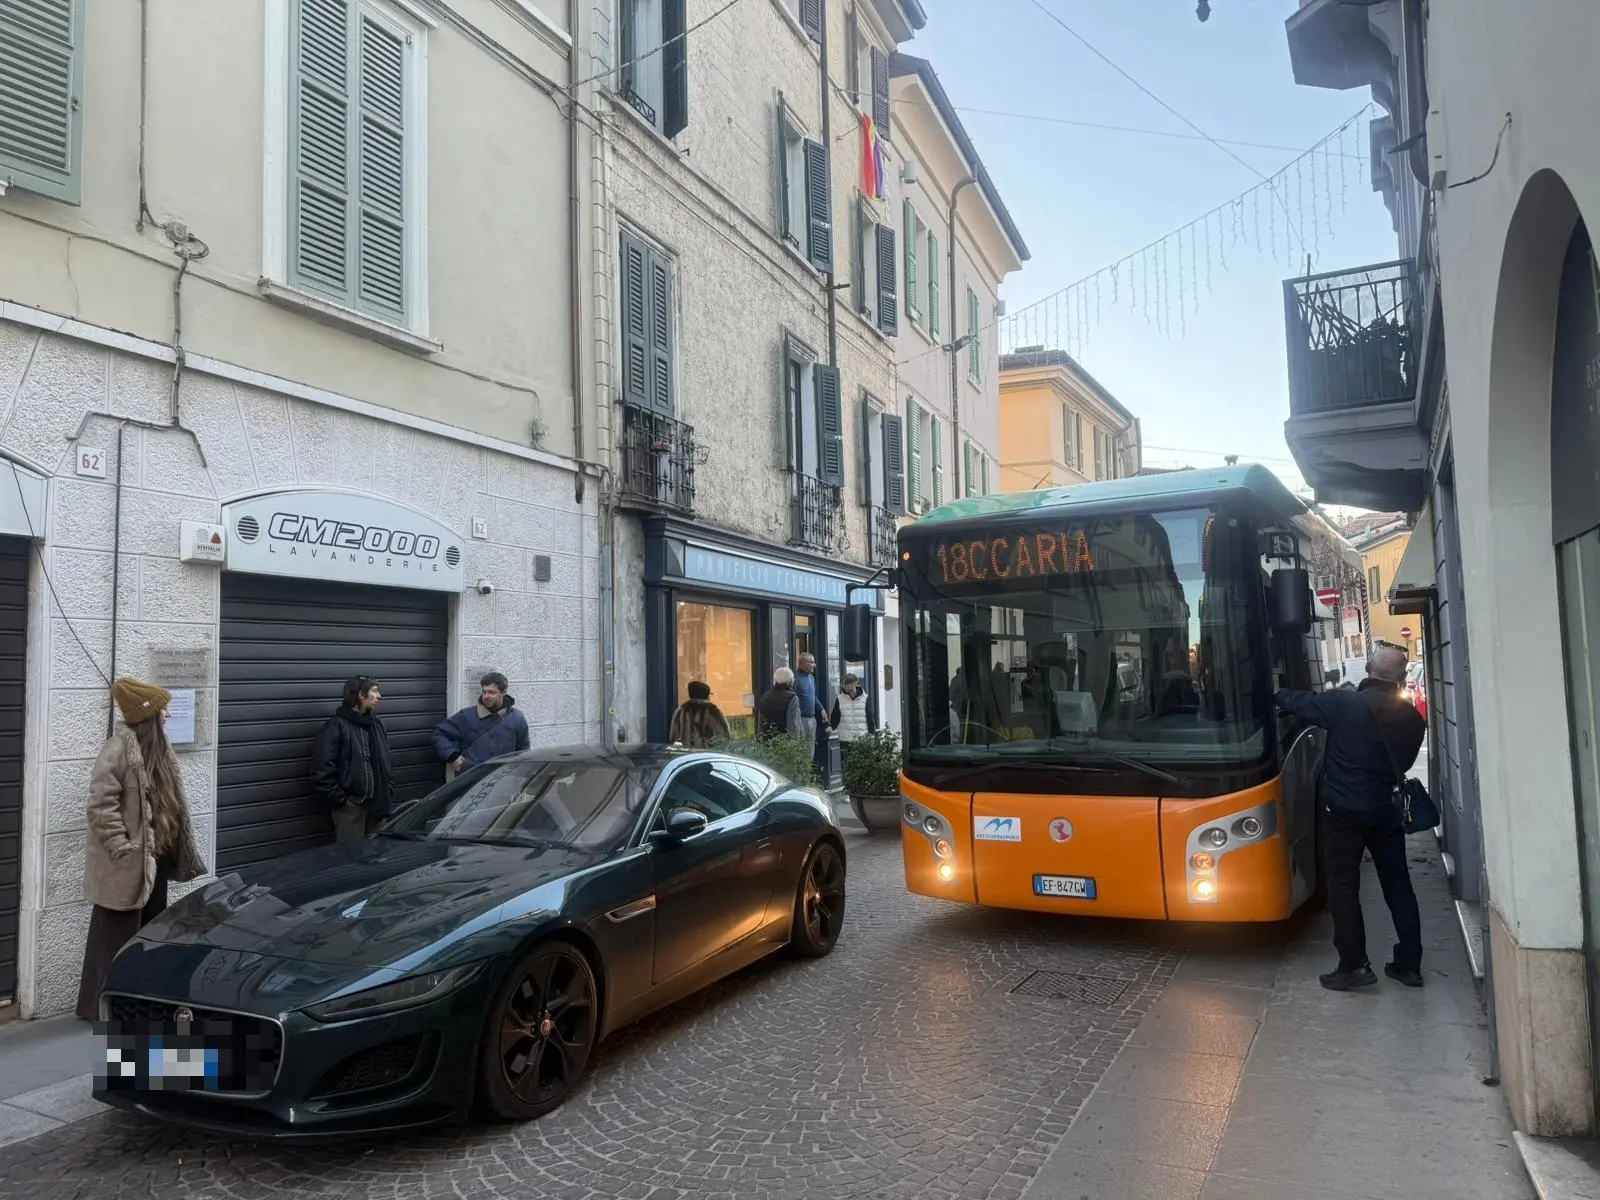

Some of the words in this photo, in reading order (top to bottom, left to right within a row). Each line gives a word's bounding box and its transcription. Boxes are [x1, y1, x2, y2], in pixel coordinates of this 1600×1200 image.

[268, 512, 440, 559] CM2000
[269, 544, 438, 572] LAVANDERIE
[697, 554, 769, 584] PANIFICIO
